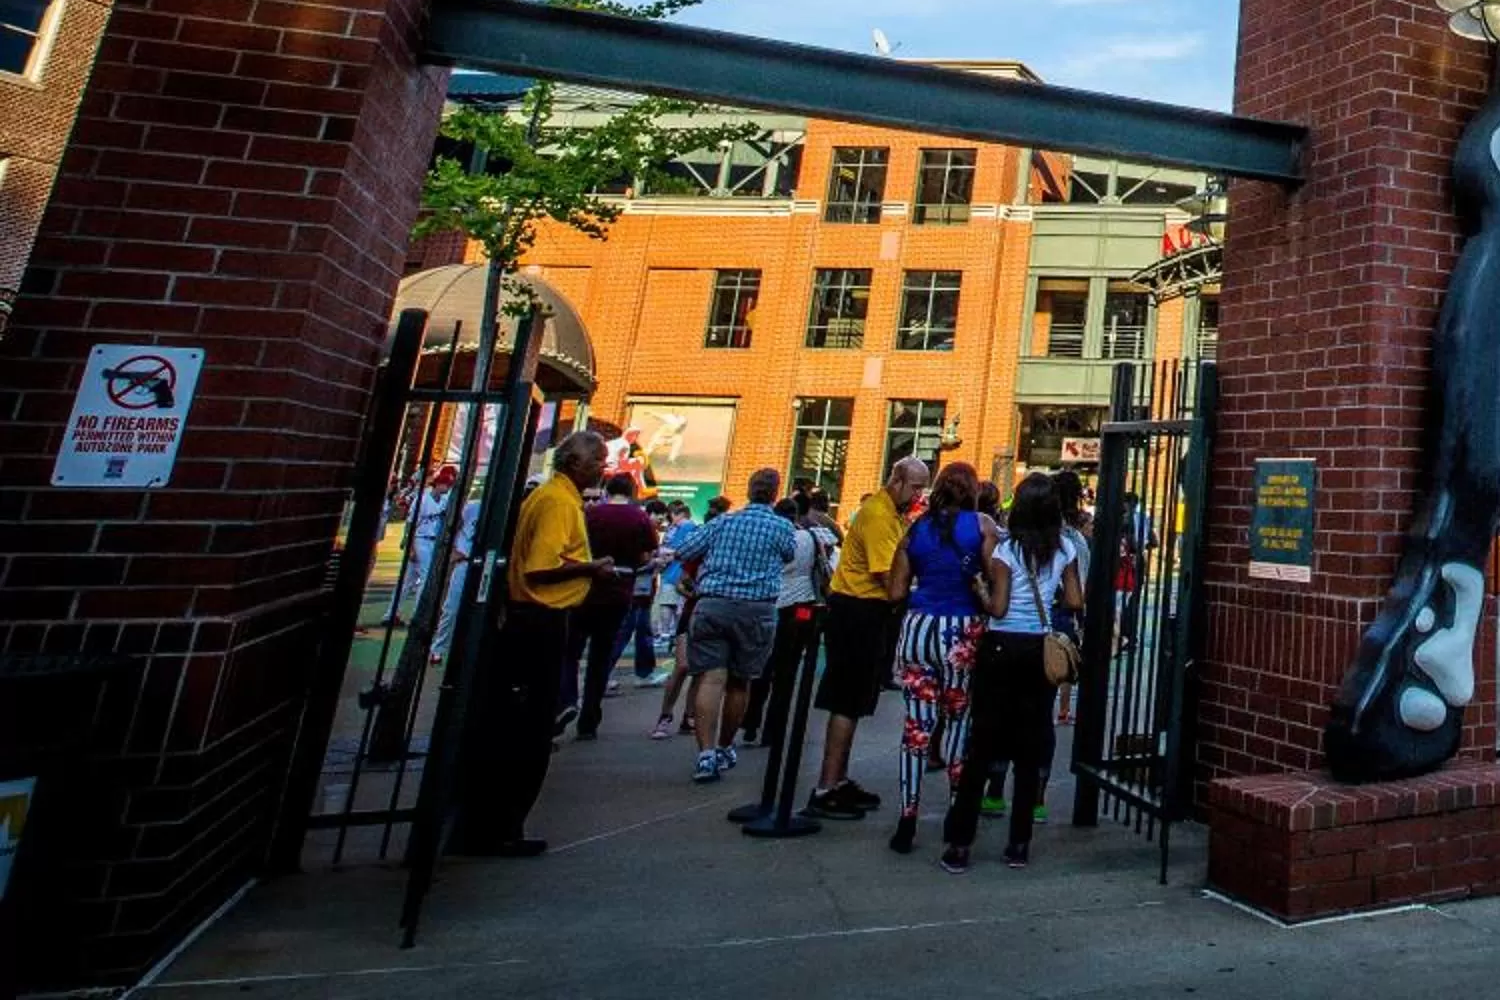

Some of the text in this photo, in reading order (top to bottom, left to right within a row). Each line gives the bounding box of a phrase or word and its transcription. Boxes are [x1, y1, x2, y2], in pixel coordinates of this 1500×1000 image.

[76, 415, 180, 431] NO FIREARMS
[71, 430, 177, 443] PERMITTED WITHIN
[74, 441, 167, 454] AUTOZONE PARK
